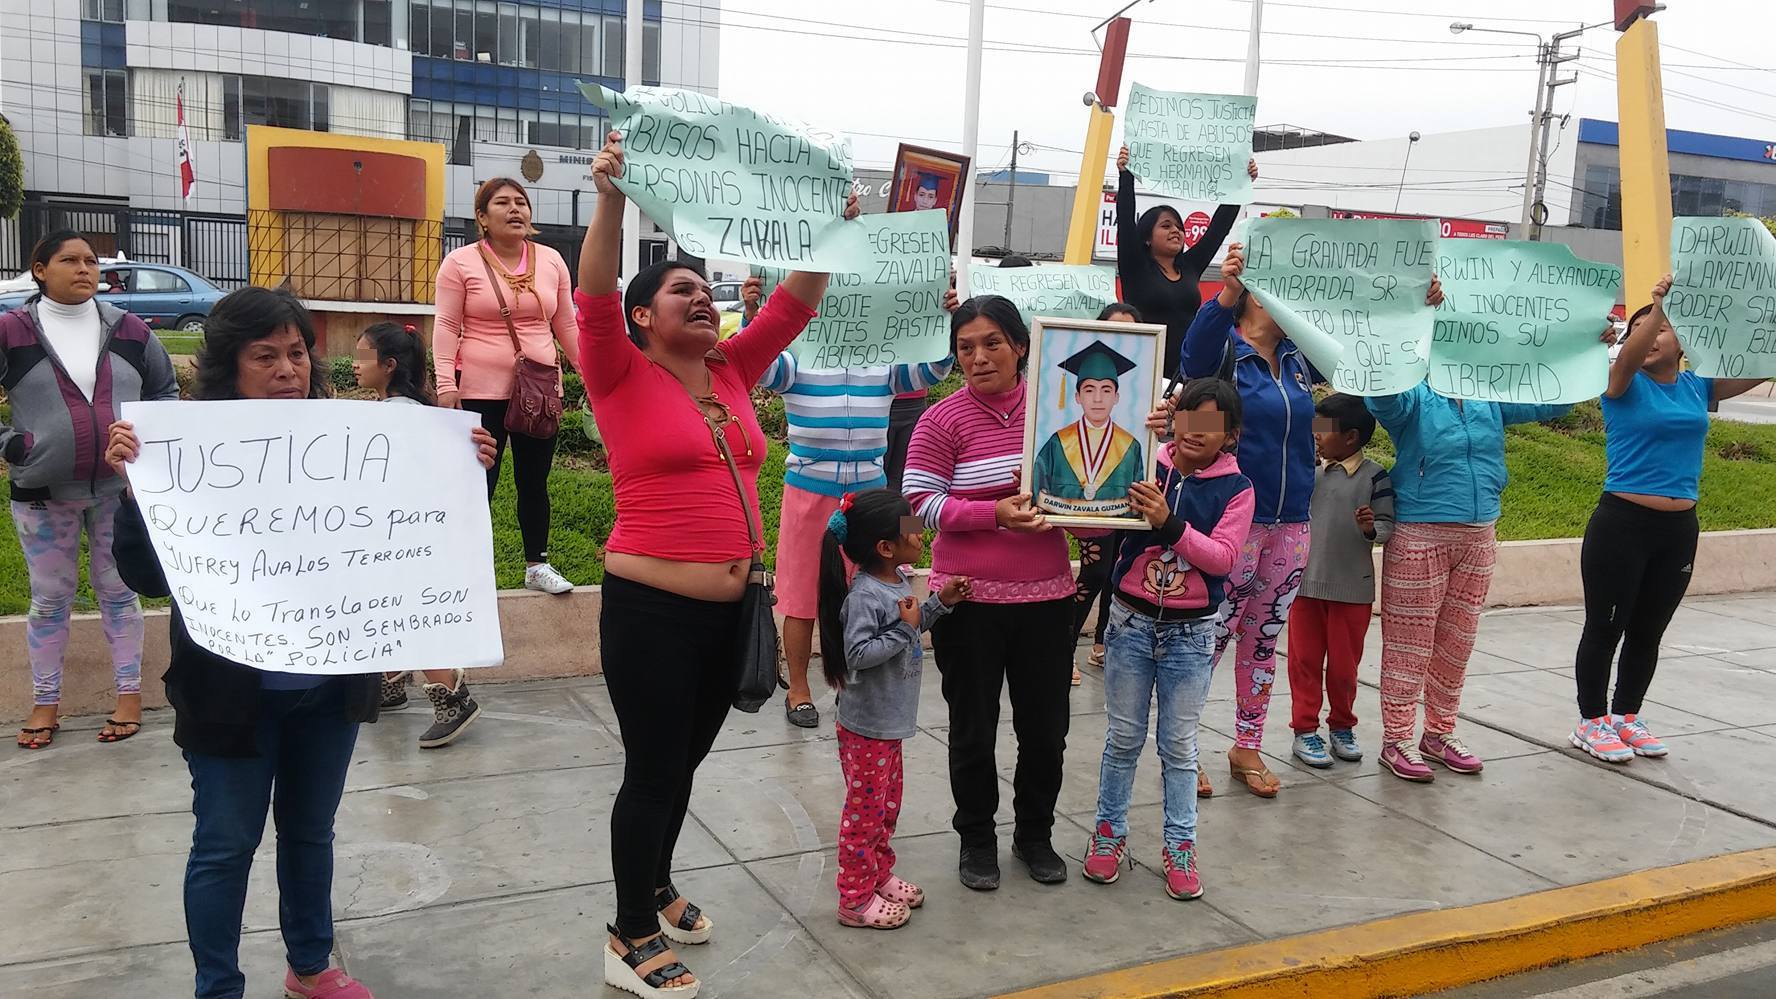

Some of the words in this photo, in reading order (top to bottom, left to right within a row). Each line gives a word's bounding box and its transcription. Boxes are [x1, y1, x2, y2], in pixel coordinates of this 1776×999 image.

[1131, 91, 1204, 120] PEDIMOS
[619, 115, 719, 160] ABUSOS
[736, 128, 811, 166] HACIA
[1130, 119, 1170, 139] VASTA
[1176, 122, 1190, 141] DE
[1198, 124, 1254, 144] ABUSOS
[559, 154, 594, 165] MINIS
[1129, 141, 1154, 160] QUE
[1163, 143, 1232, 164] REGRESEN
[1159, 163, 1233, 181] HERMANOS
[1149, 179, 1209, 200] ZABALA
[868, 226, 945, 255] EGRESEN
[1245, 235, 1273, 270] LA
[1291, 232, 1379, 269] GRANADA
[1392, 240, 1433, 267] FUE
[1678, 225, 1763, 257] DARWIN
[874, 255, 946, 285] ZAVALA
[972, 271, 1000, 293] QUE
[1010, 273, 1081, 293] REGRESEN
[1087, 274, 1110, 292] LOS
[1510, 259, 1522, 283] Y
[1527, 262, 1622, 290] ALEXANDER
[894, 288, 940, 315] SON
[1052, 295, 1106, 312] ZAVALA
[1470, 293, 1570, 323] INOCENTES
[1667, 291, 1733, 323] PODER
[802, 320, 868, 345] ENTES
[883, 315, 946, 341] BASTA
[1342, 308, 1380, 338] DEL
[1517, 322, 1550, 348] SU
[1355, 340, 1392, 370] QUE
[140, 425, 391, 494] JUSTICIA
[1043, 497, 1072, 511] DARWIN
[1072, 504, 1100, 513] ZAVALA
[1101, 502, 1130, 512] GUZMAN
[149, 503, 374, 539] QUEREMOS
[387, 507, 446, 540] para
[251, 548, 330, 582] AVALOS
[341, 545, 433, 568] TERRONES
[420, 585, 470, 607] SON
[304, 624, 351, 651] SON
[364, 611, 473, 639] SEMBRADOS
[208, 639, 236, 657] POR
